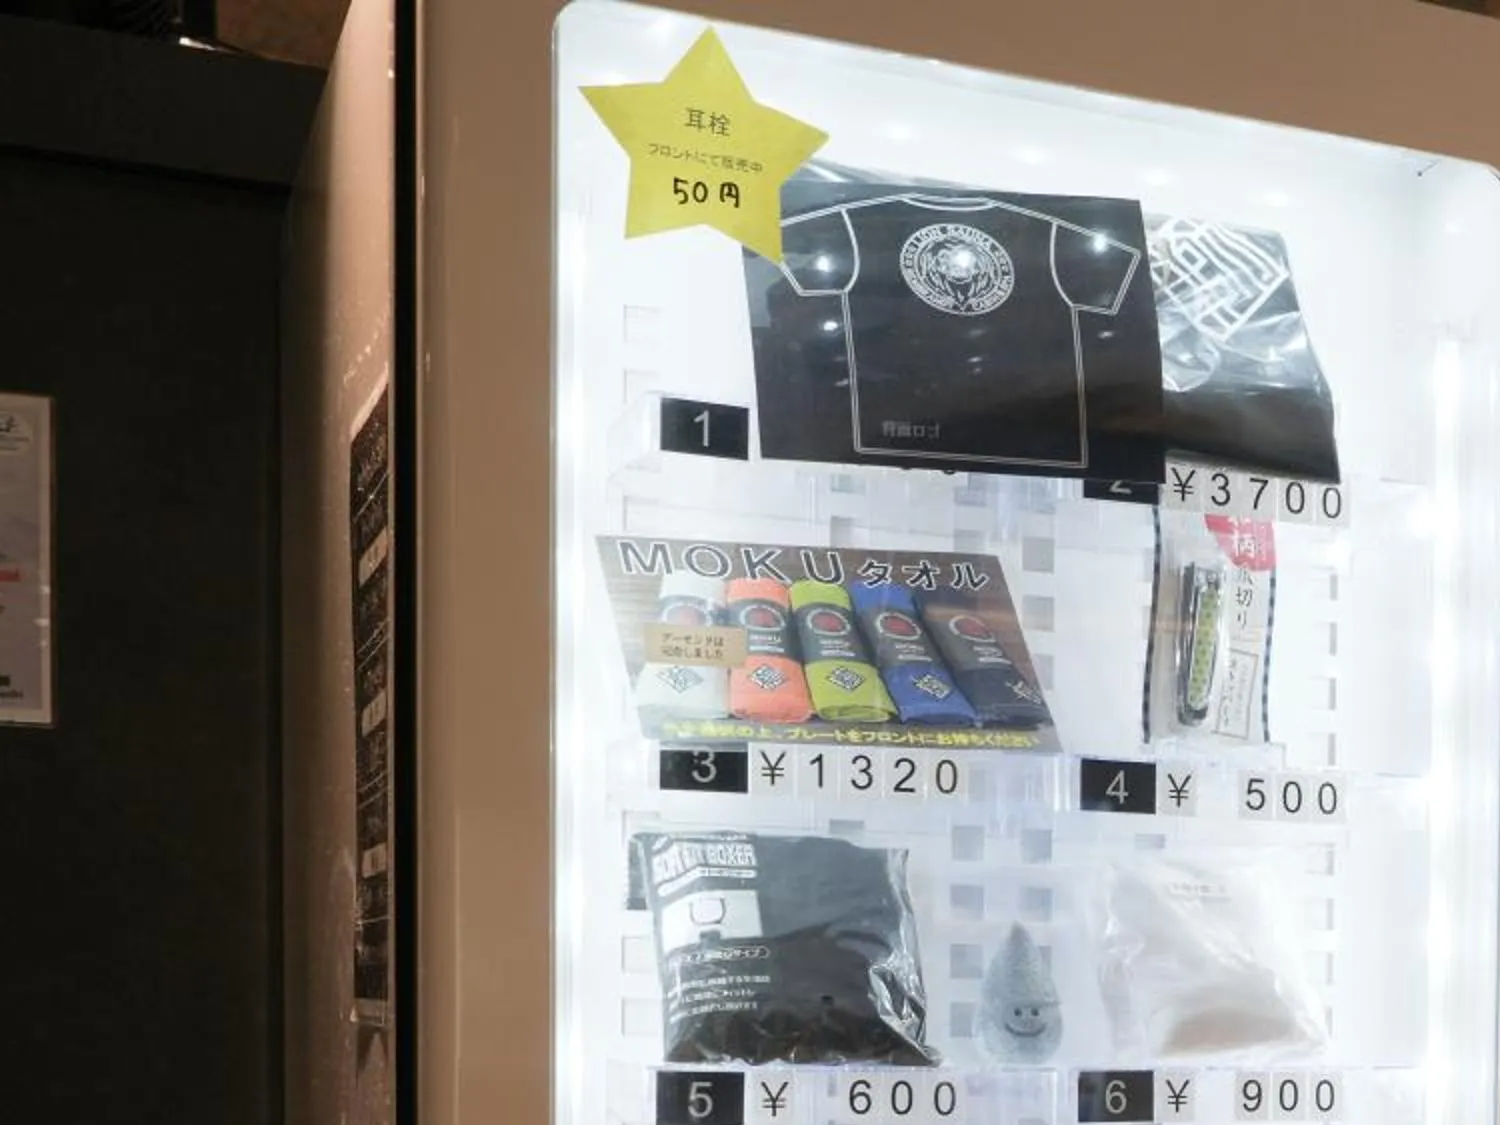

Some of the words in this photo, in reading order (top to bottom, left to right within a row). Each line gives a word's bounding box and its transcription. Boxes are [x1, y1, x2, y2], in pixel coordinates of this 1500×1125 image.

[684, 107, 732, 137] 耳栓
[648, 142, 764, 175] フロントにて販売中
[695, 411, 711, 446] 1
[691, 747, 717, 782] 3
[1105, 770, 1129, 804] 4
[687, 1081, 713, 1118] 5
[1105, 1080, 1127, 1113] 6
